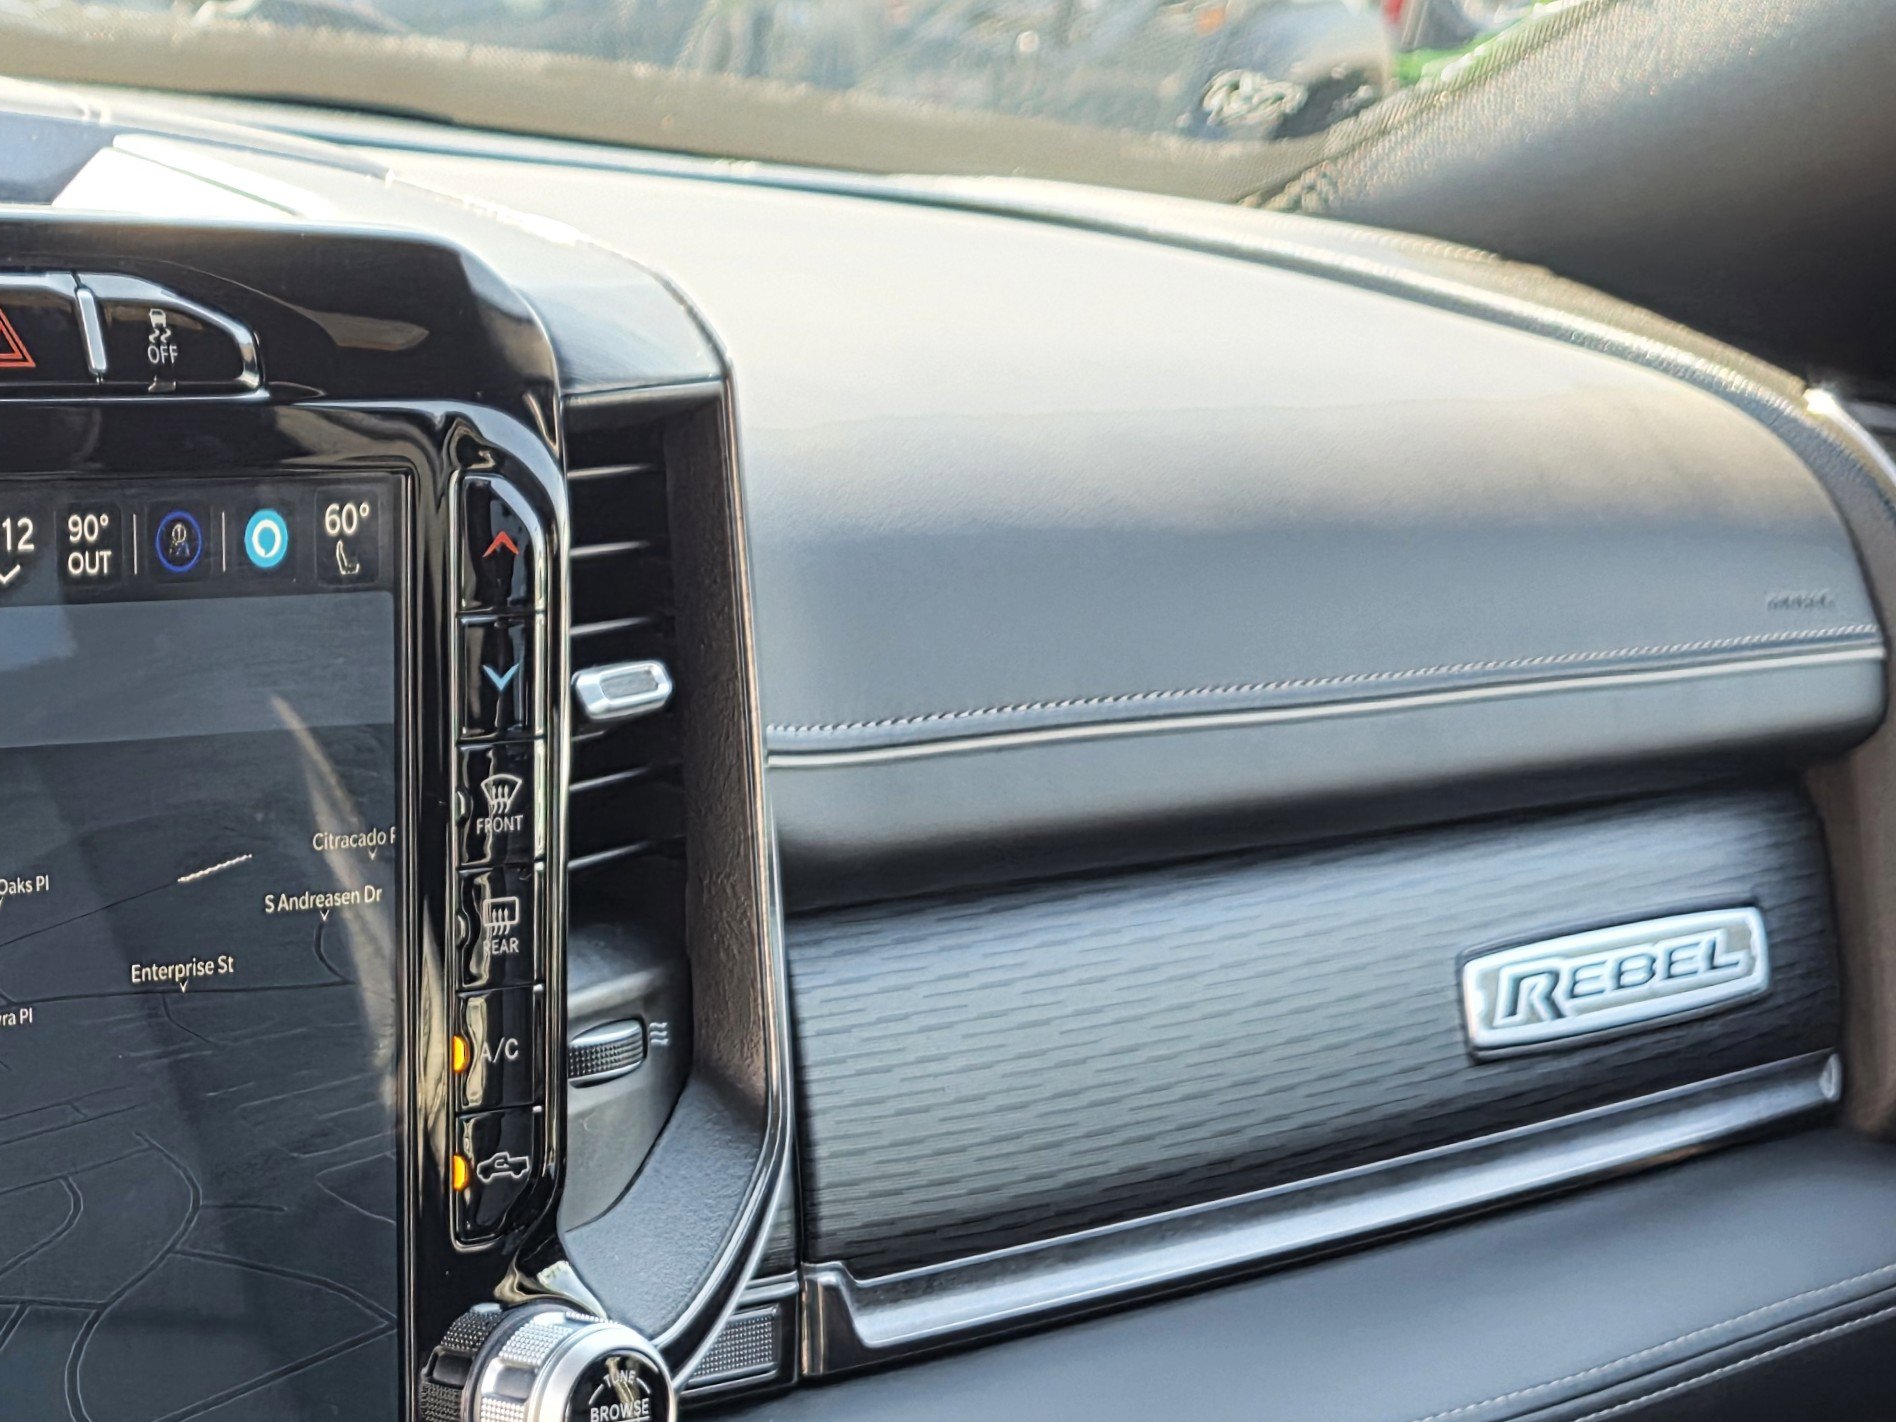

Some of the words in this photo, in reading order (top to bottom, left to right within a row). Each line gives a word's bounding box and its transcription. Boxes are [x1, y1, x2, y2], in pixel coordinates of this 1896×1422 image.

[147, 345, 178, 364] OFF
[68, 514, 109, 543] 90°
[324, 502, 370, 536] 60°
[68, 550, 111, 575] OUT
[476, 815, 524, 835] FRONT
[312, 827, 387, 851] Citracado
[36, 875, 49, 891] Pl
[265, 894, 275, 913] S
[278, 889, 360, 912] Andreasen
[364, 885, 383, 903] Dr
[483, 938, 519, 956] REAR
[131, 957, 214, 983] Enterprise
[218, 955, 234, 974] St
[1493, 928, 1752, 1029] REBEL
[19, 1007, 33, 1024] Pl
[480, 1037, 519, 1063] A/C
[603, 1368, 636, 1387] TUNE
